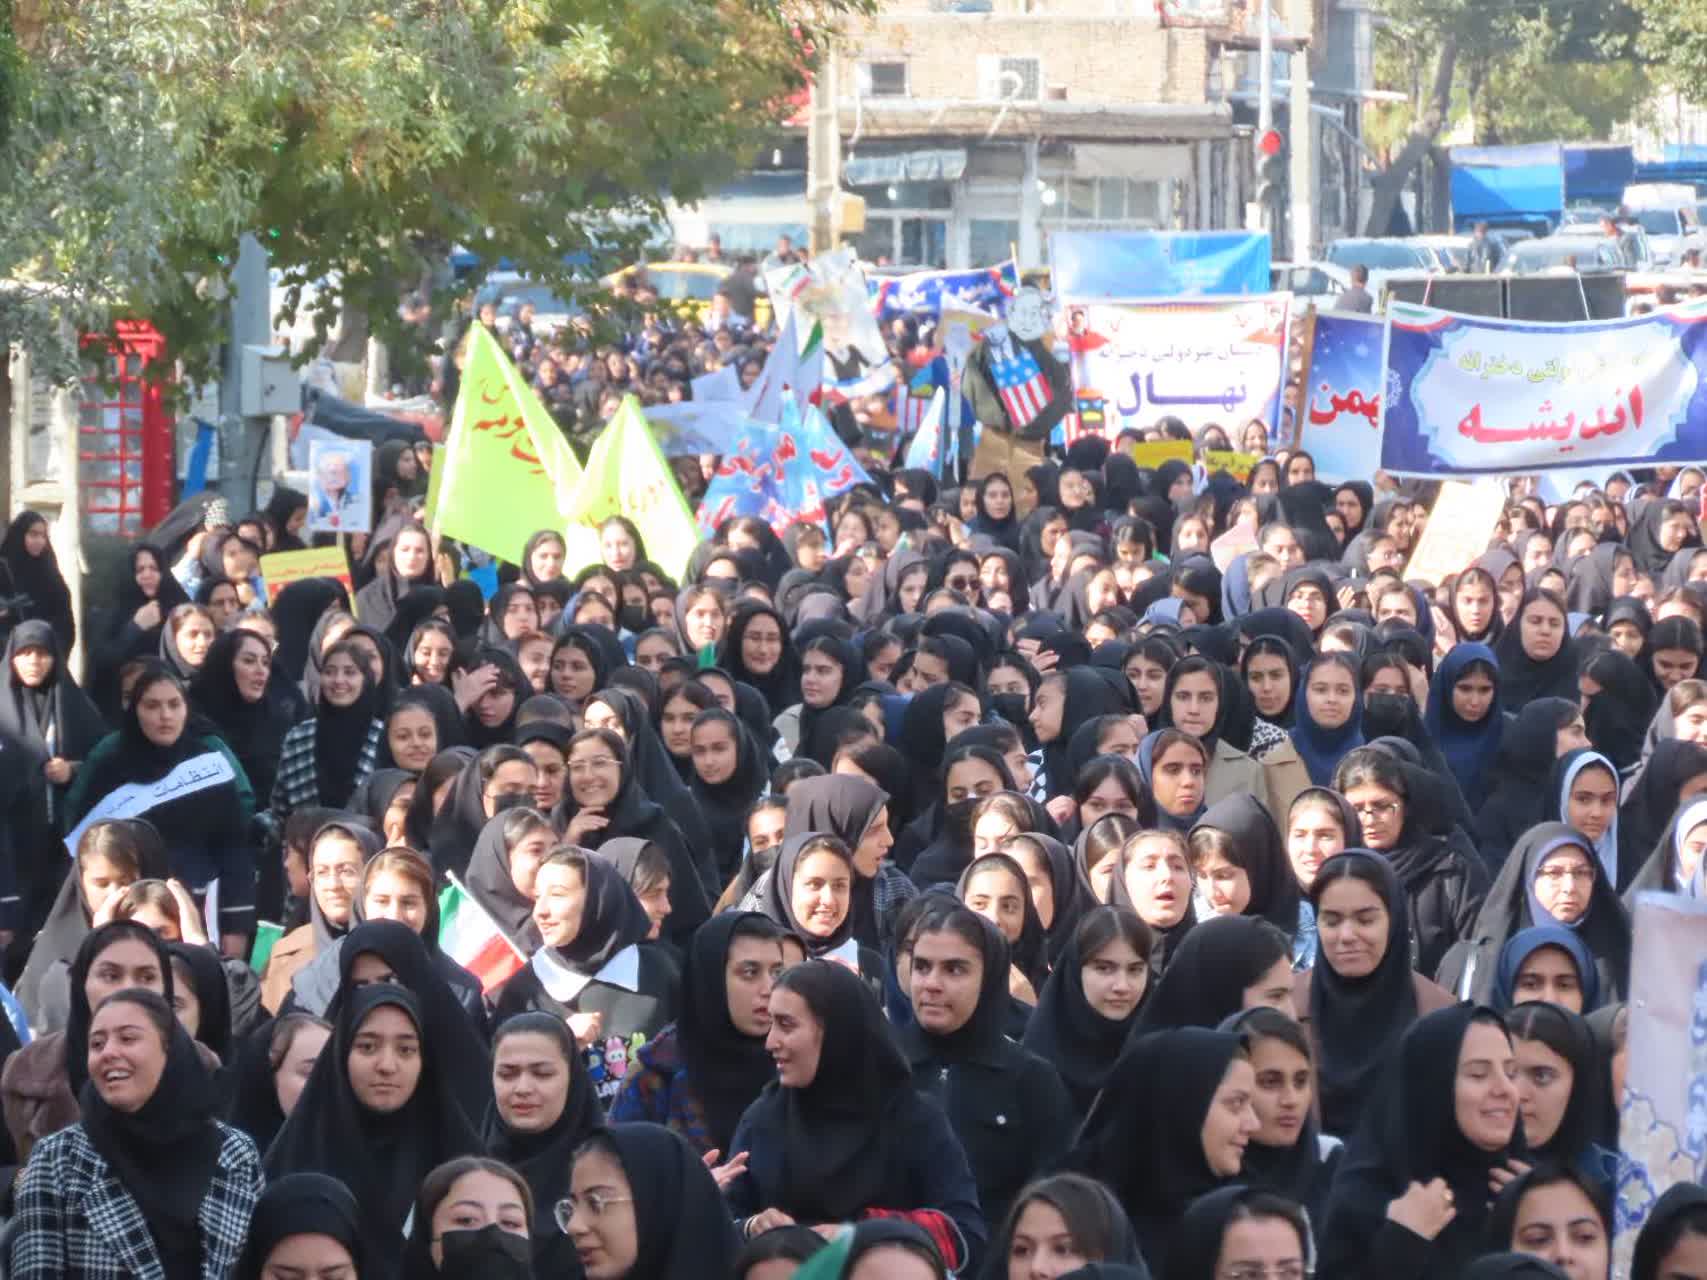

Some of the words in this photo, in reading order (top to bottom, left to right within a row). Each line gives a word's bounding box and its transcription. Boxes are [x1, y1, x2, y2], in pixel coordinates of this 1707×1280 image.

[1457, 349, 1523, 380] دخترانه
[1116, 370, 1247, 417] نهال
[1457, 383, 1645, 452] اندیشه
[153, 763, 224, 798] انتظامات
